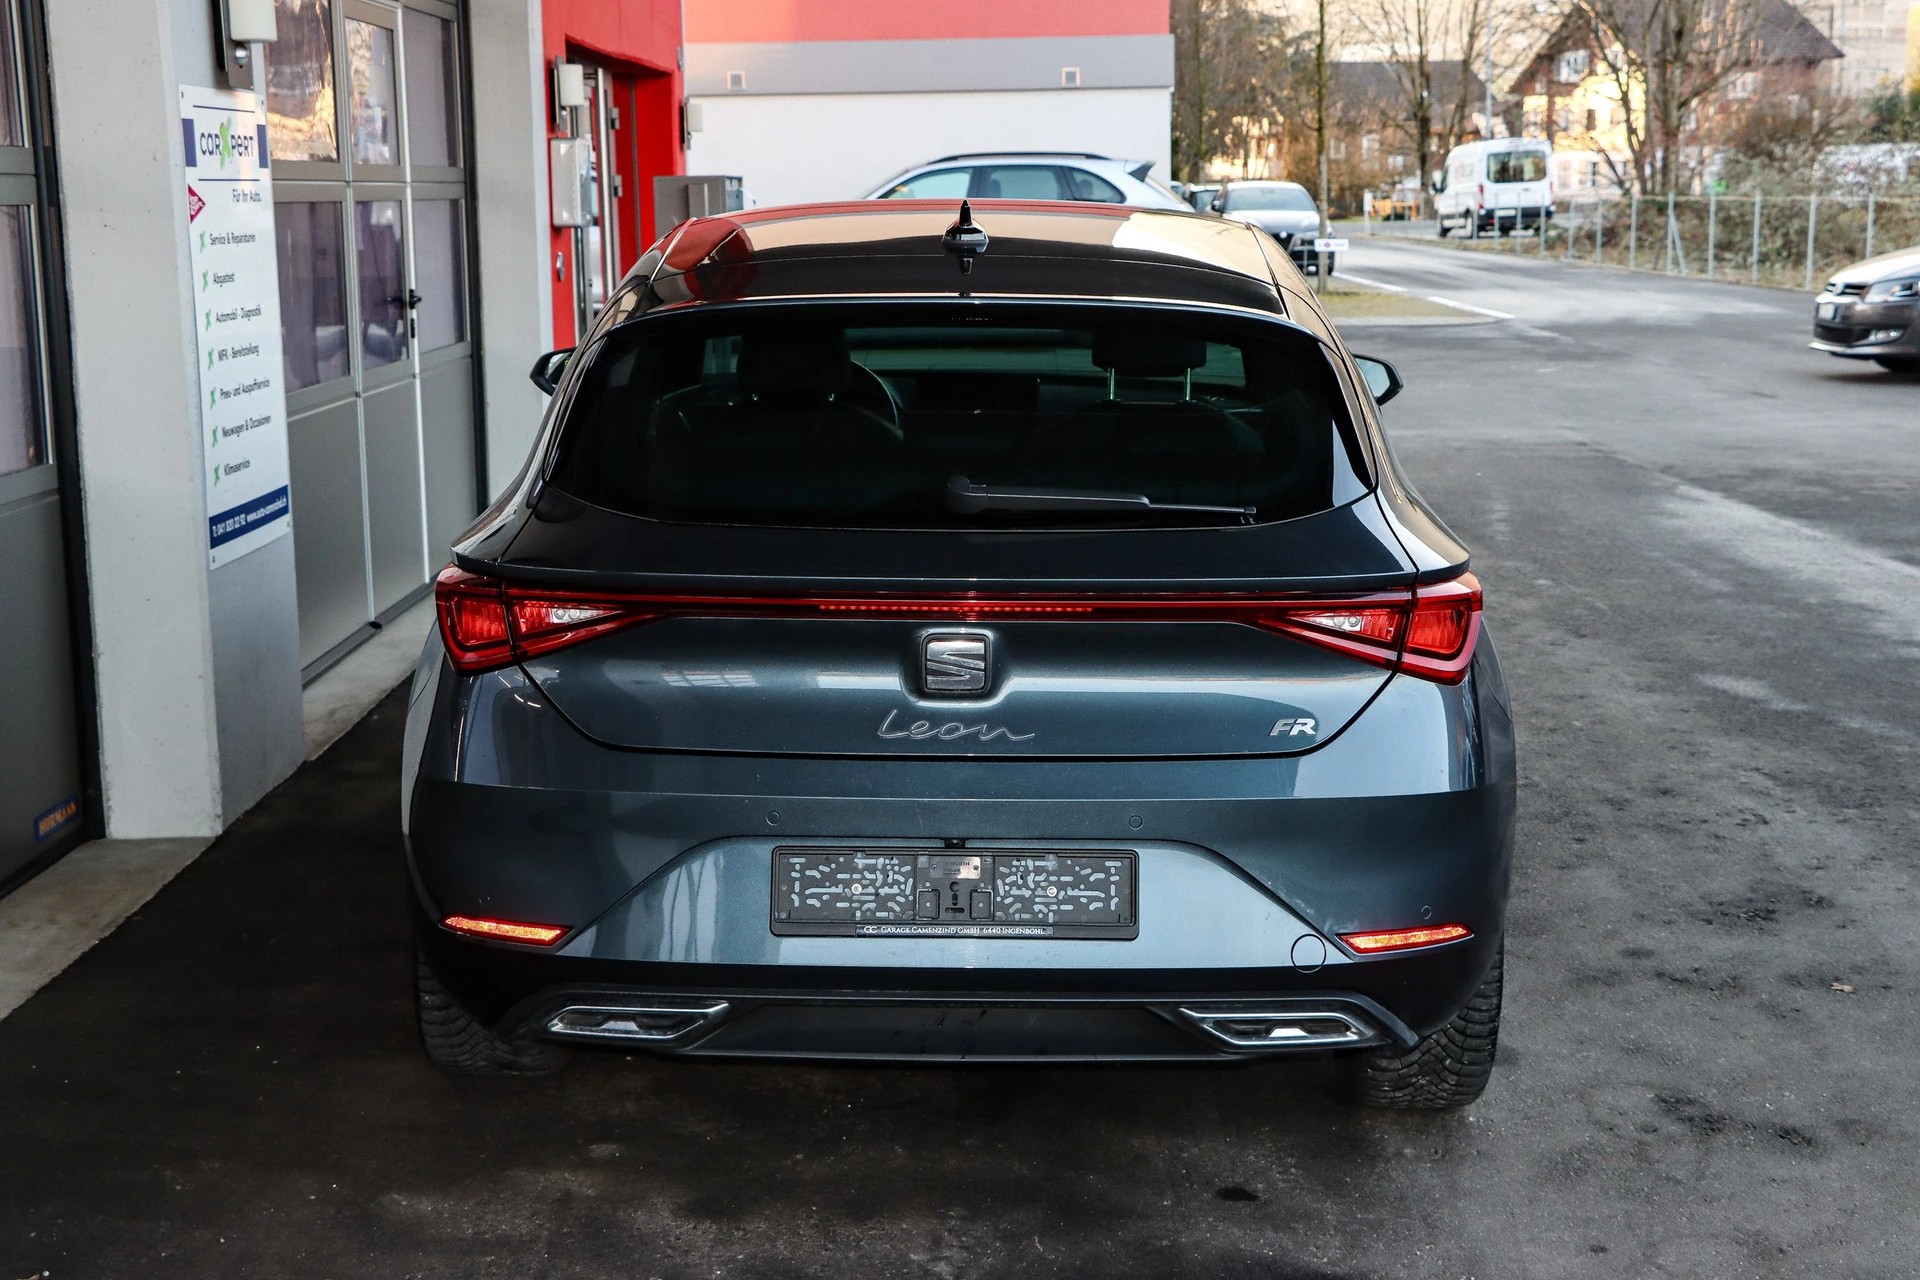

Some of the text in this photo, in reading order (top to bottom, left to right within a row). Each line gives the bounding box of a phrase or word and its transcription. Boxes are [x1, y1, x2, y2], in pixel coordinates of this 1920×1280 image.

[210, 232, 226, 246] Service
[877, 708, 1036, 742] Leon
[1267, 717, 1317, 737] FR
[911, 926, 957, 935] CAMENZIND
[983, 926, 1001, 935] 6440
[1002, 927, 1045, 935] INGENBOHL
